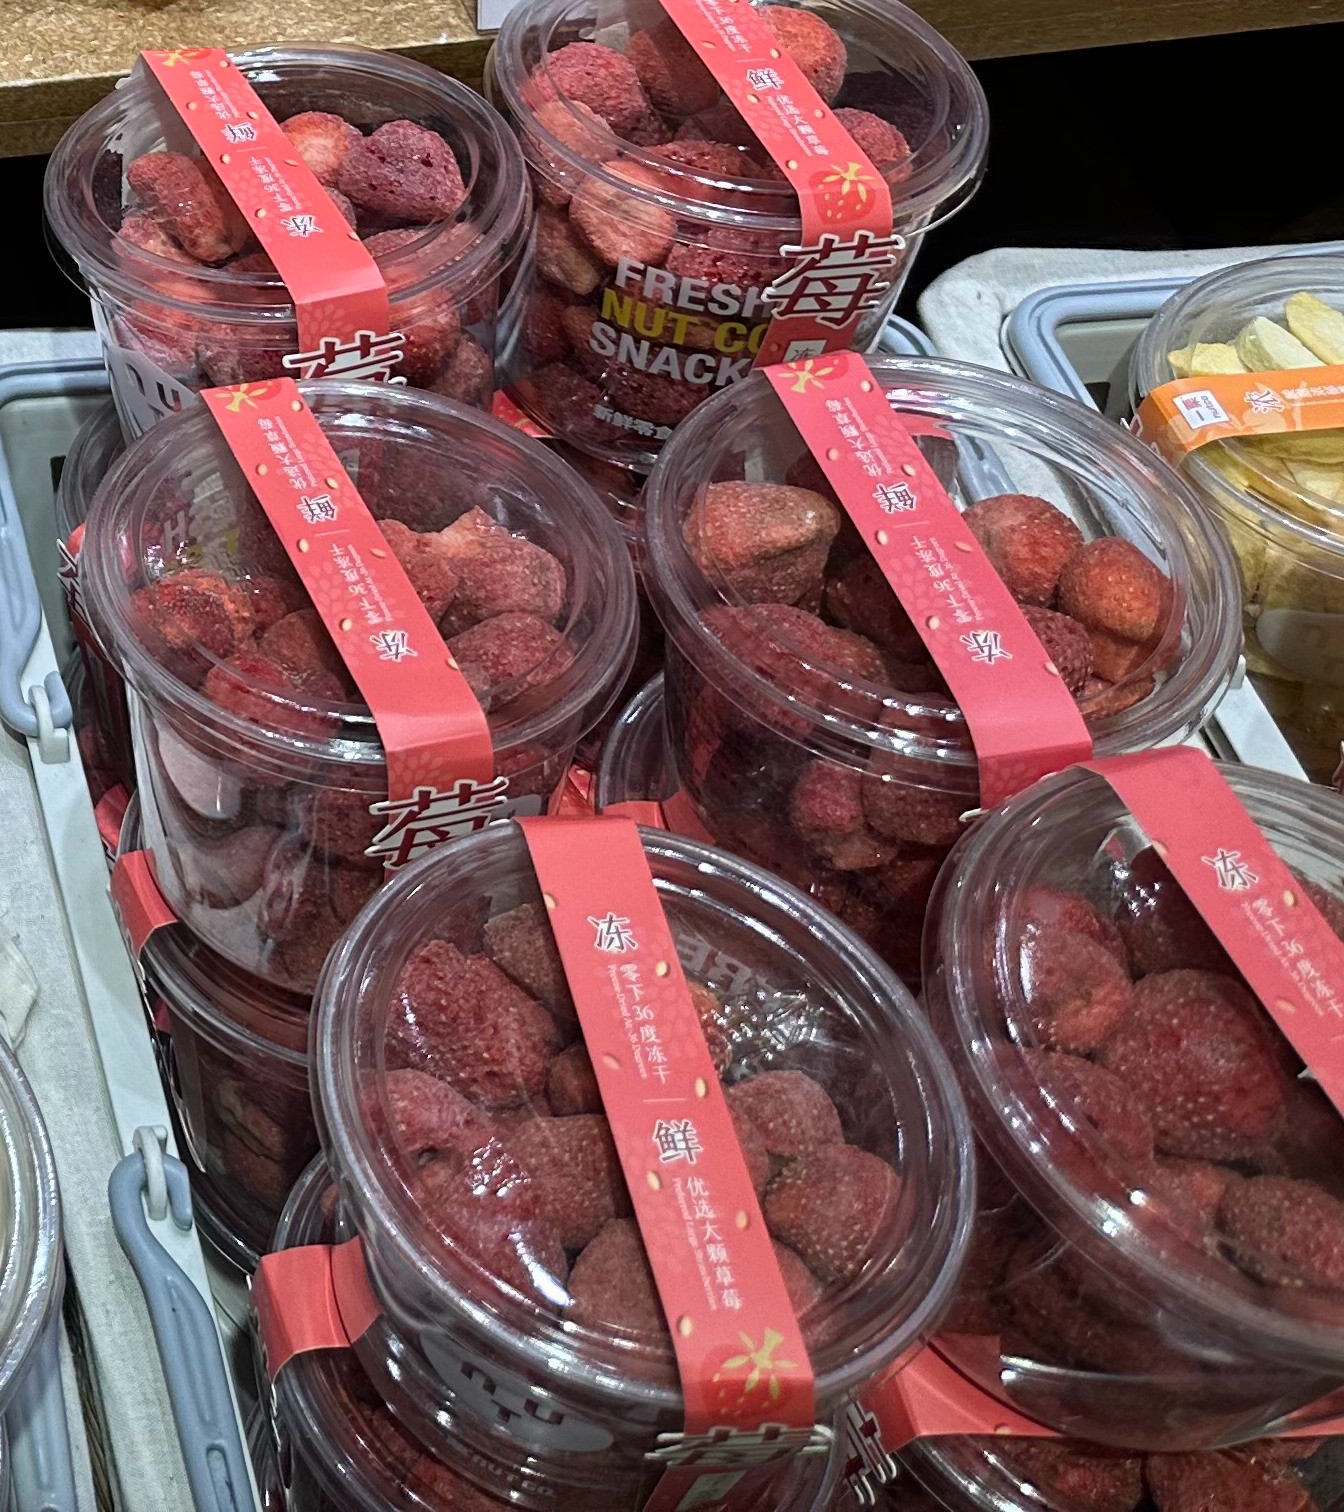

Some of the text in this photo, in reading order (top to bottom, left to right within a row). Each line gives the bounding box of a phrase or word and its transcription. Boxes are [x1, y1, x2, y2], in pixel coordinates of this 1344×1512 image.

[614, 256, 772, 320] FRESH
[764, 235, 904, 327] 莓
[600, 288, 700, 346] NUT
[588, 326, 754, 387] SNACK
[875, 483, 915, 512] 鲜
[373, 631, 415, 662] 冻
[962, 631, 1012, 663] 冻
[1203, 850, 1256, 889] 冻
[589, 915, 638, 952] 冻
[653, 1121, 700, 1163] 鲜
[685, 1177, 743, 1310] 优选大颗草莓
